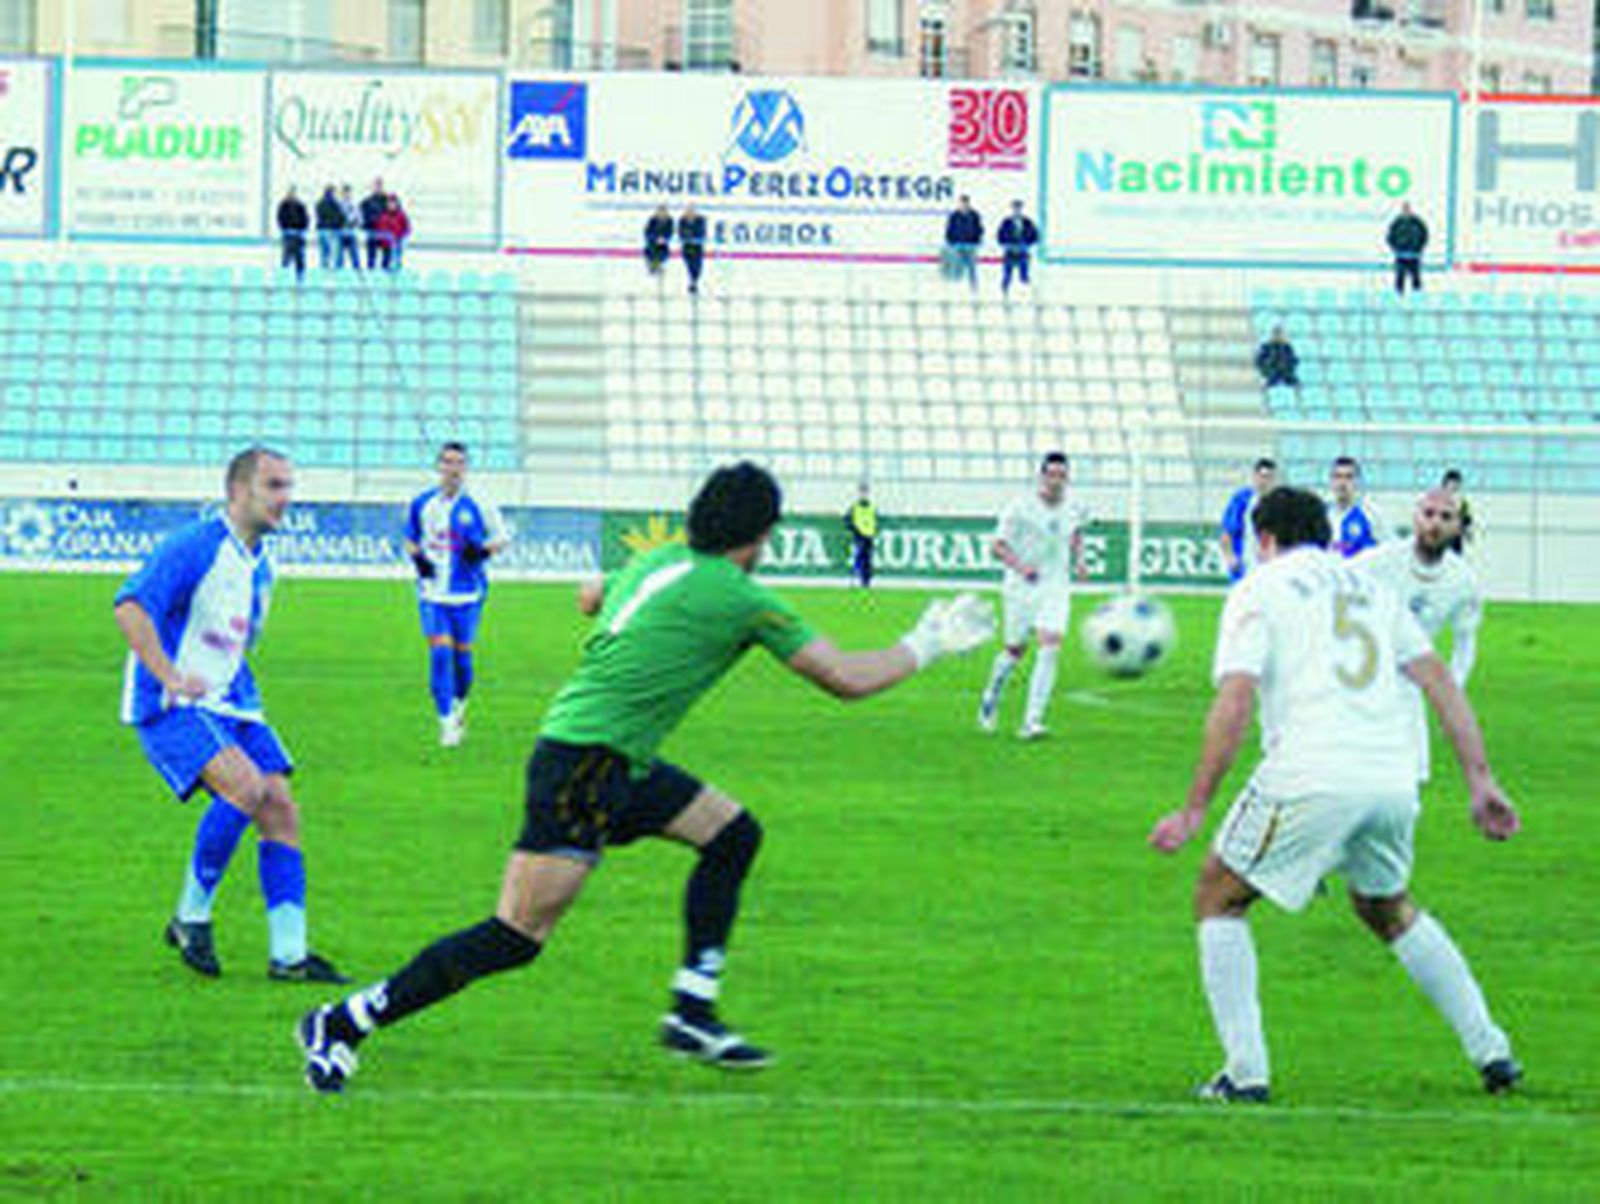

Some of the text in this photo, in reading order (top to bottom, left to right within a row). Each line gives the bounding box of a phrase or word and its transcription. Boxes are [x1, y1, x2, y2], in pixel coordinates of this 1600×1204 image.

[75, 123, 242, 160] PLADUR
[508, 114, 573, 147] AXA
[0, 147, 38, 193] R
[1074, 152, 1412, 197] Nacimiento
[713, 221, 834, 245] EGUROS
[757, 527, 833, 567] AJA
[1080, 536, 1107, 574] E
[1333, 591, 1378, 690] 5
